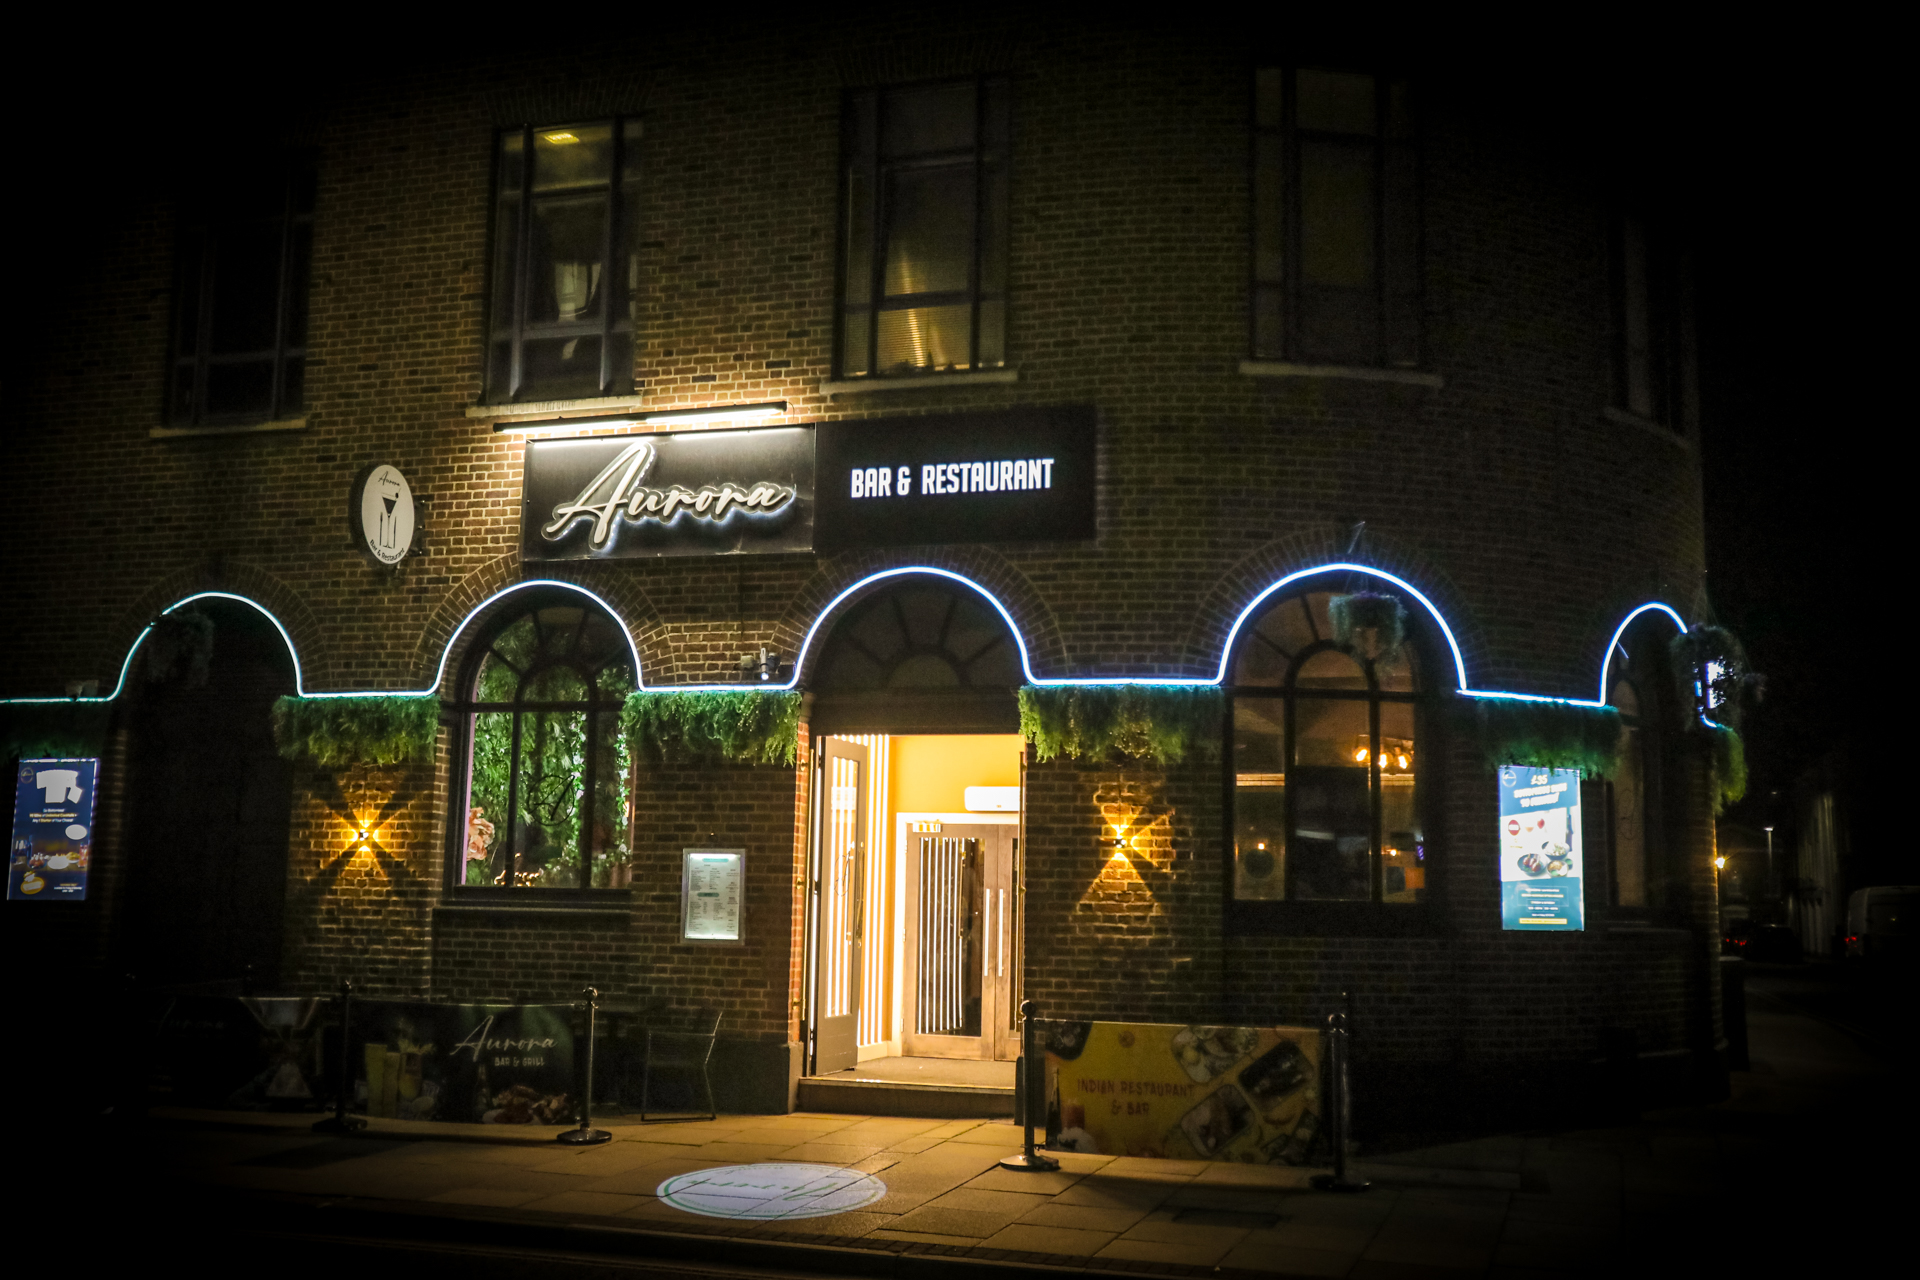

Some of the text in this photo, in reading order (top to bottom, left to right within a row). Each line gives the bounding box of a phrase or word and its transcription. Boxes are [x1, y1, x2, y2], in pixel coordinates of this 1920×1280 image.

[543, 440, 790, 546] Aurora
[850, 458, 1055, 499] BAR & RESTAURANT
[449, 1014, 558, 1063] Aurora
[494, 1057, 545, 1067] BAR & GRILL
[1077, 1079, 1195, 1097] INDIAN RESTAURANT
[1111, 1099, 1149, 1116] & BAR
